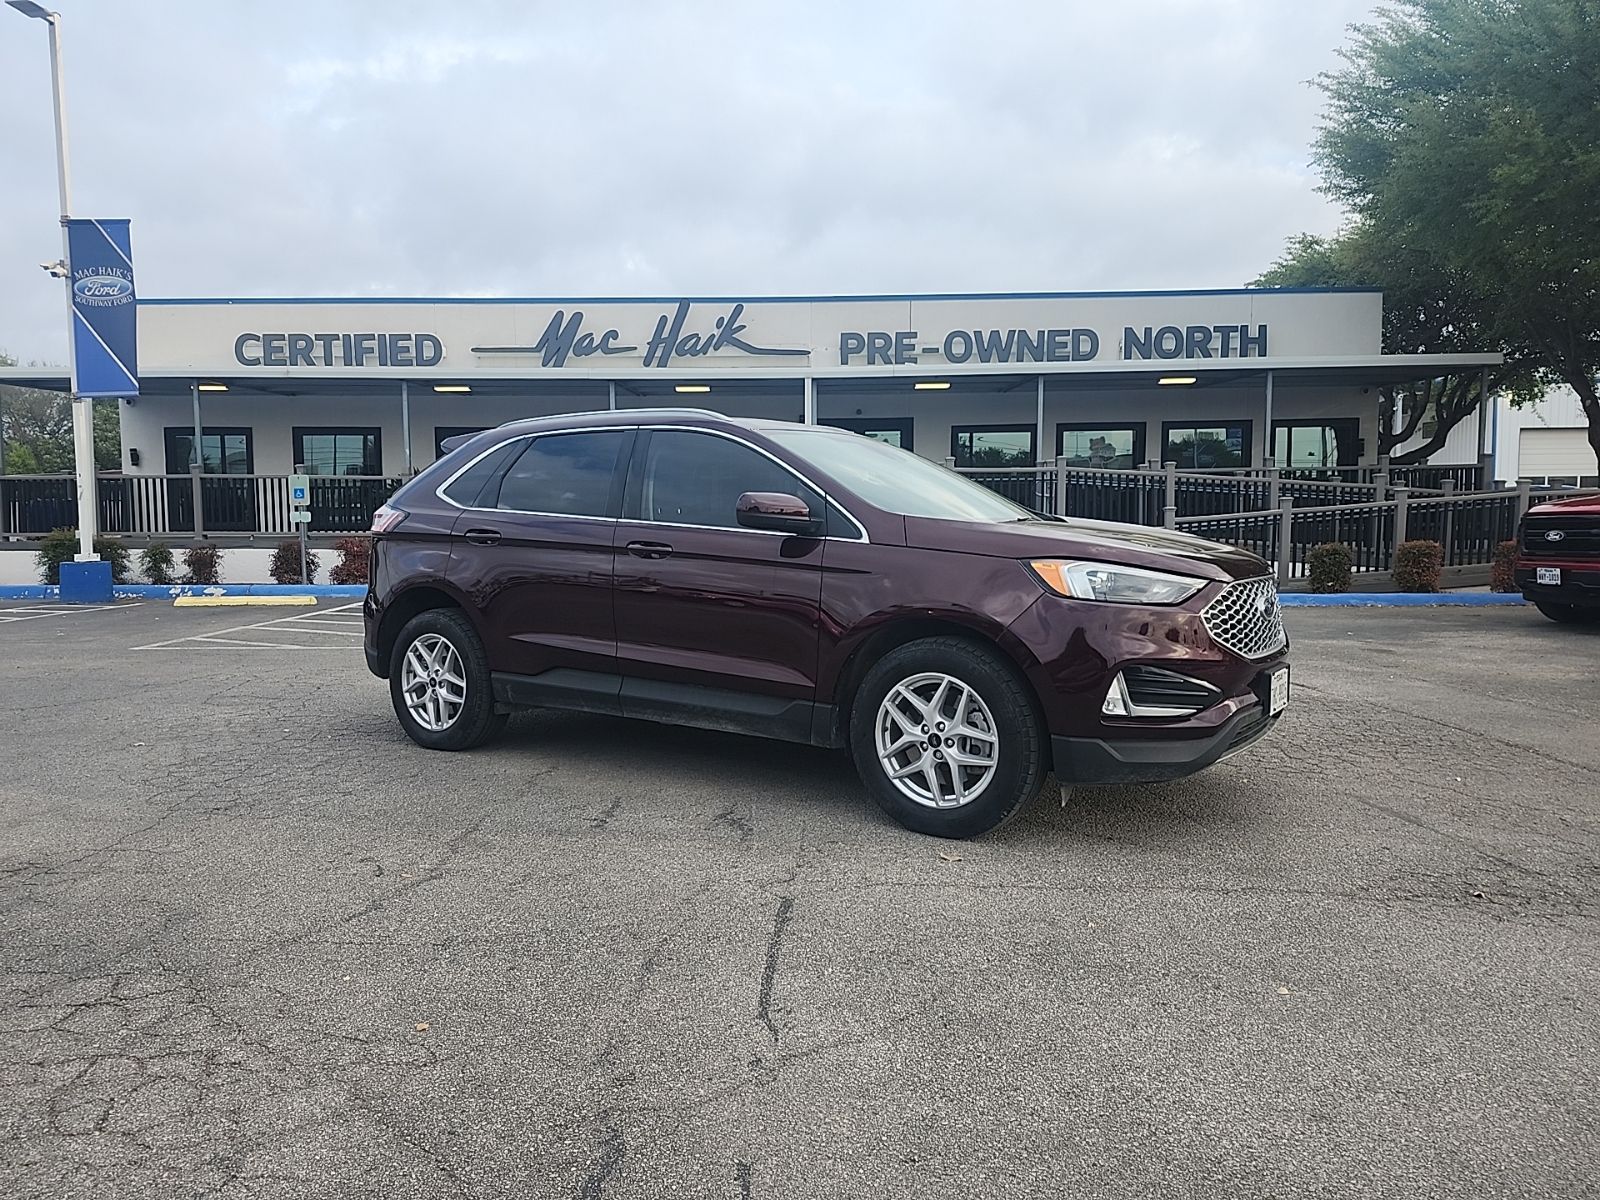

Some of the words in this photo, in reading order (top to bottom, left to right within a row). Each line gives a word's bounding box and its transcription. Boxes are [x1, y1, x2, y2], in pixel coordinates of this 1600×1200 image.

[74, 267, 96, 280] MAC
[98, 266, 132, 280] HAIK'S
[84, 280, 120, 295] Ford
[75, 296, 112, 307] SOUTHWAY
[113, 294, 133, 306] FORD
[471, 310, 637, 368] Mac
[642, 298, 811, 368] Haik
[839, 328, 1099, 366] PRE-OWNED
[1123, 324, 1269, 361] NORTH
[234, 332, 443, 367] CERTIFIED
